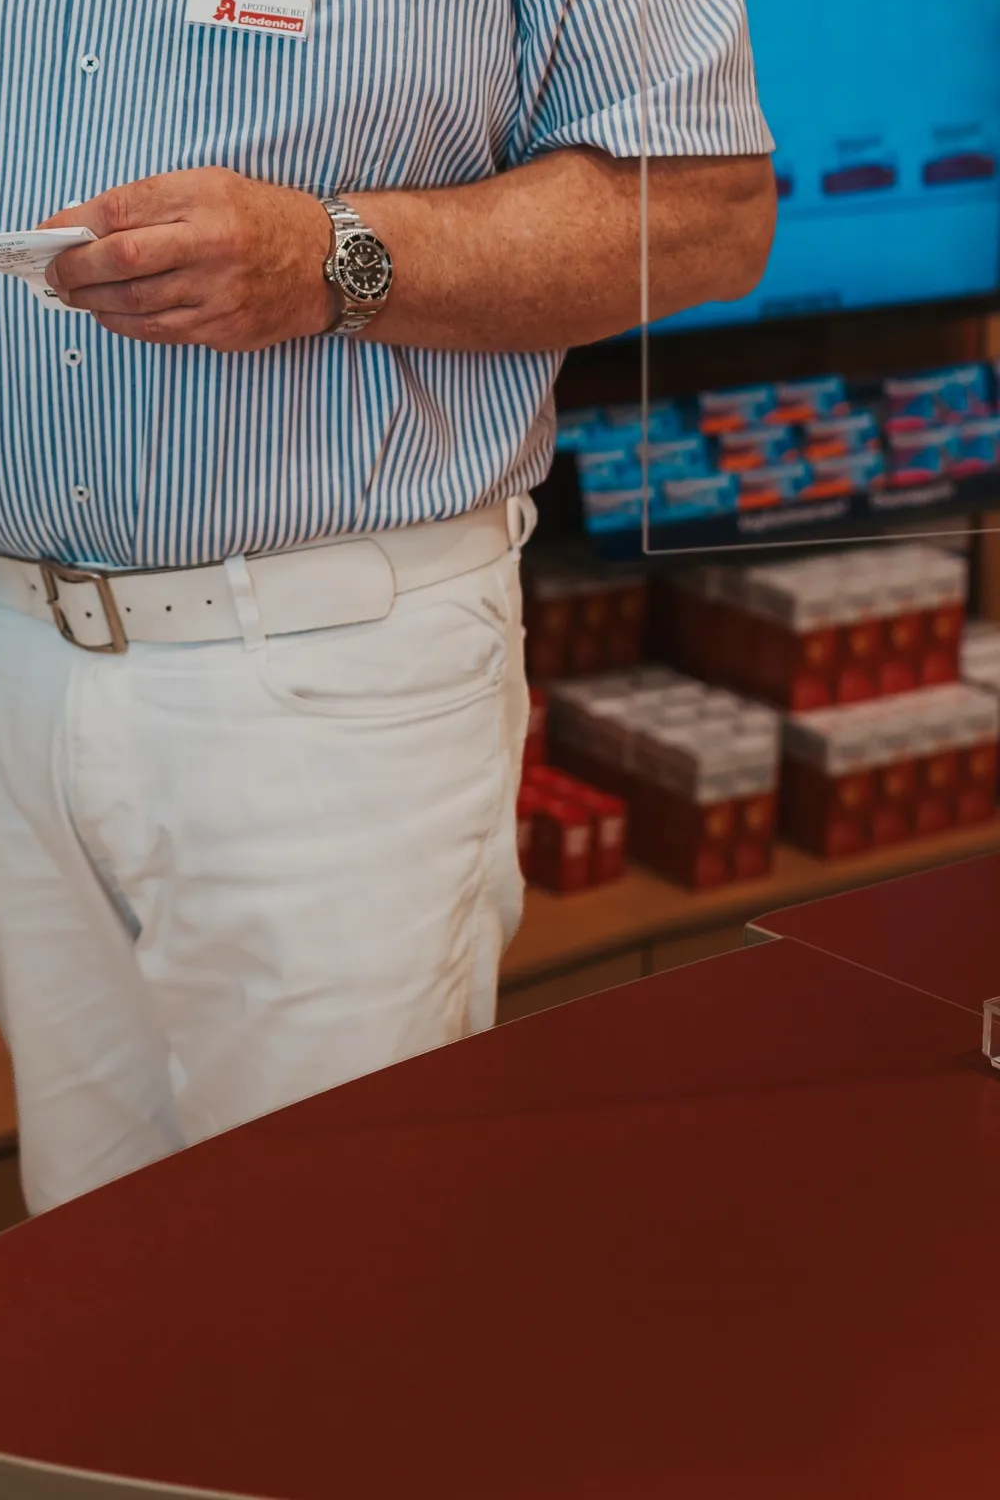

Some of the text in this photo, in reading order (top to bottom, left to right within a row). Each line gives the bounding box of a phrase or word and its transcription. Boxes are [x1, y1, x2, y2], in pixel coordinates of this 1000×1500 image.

[240, 3, 306, 18] APOTHEKE BEI
[240, 15, 302, 31] dodenhof
